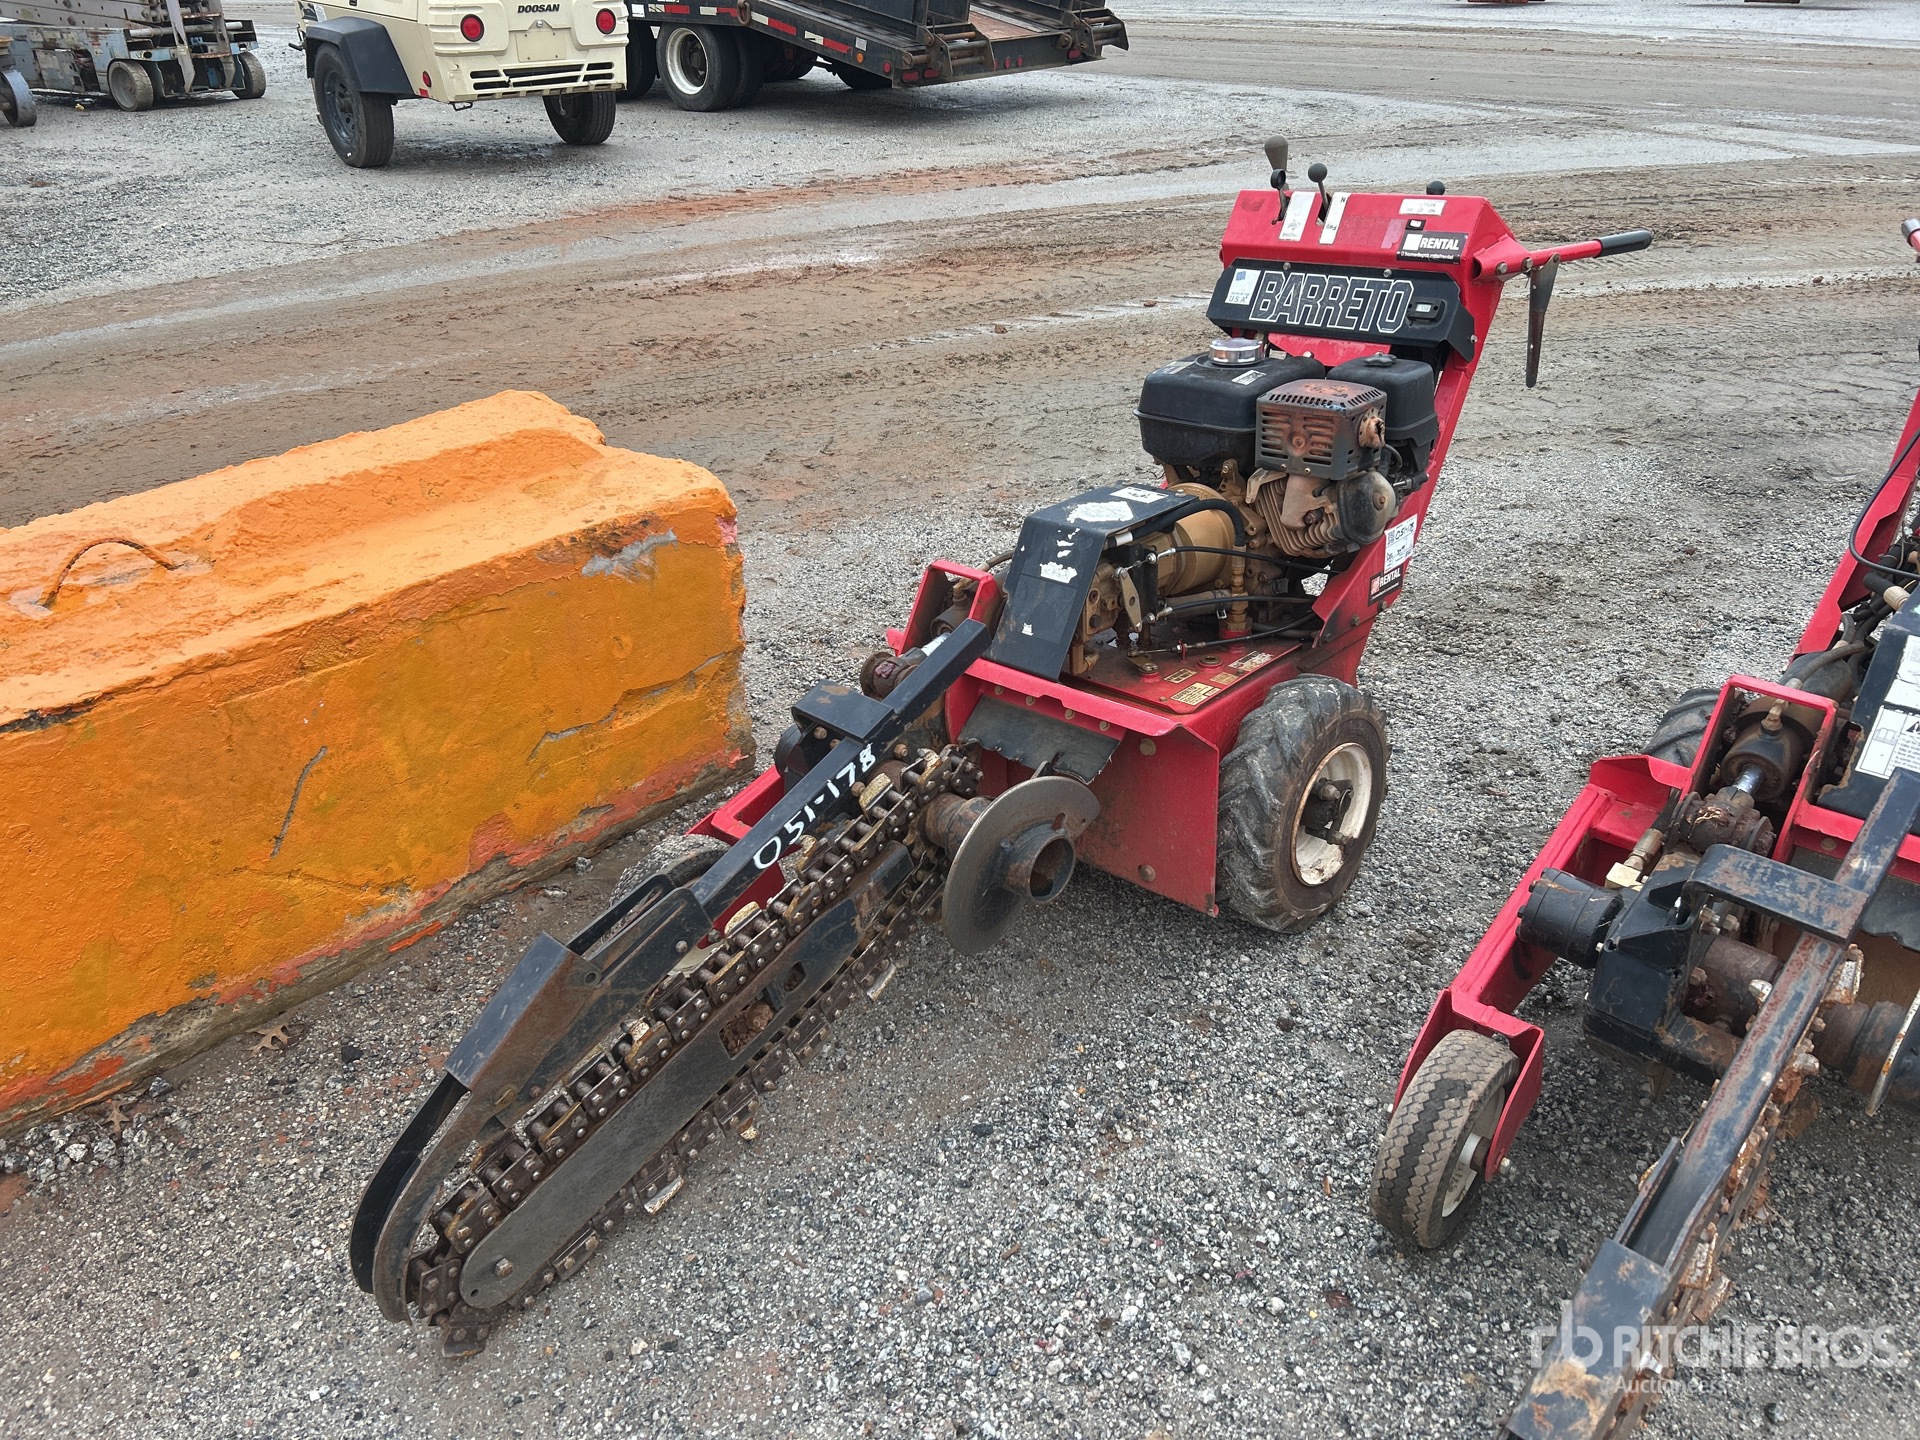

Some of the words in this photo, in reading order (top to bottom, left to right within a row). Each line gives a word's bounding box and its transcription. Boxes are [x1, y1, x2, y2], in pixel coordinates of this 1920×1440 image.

[517, 4, 560, 13] DOOSAN
[1419, 237, 1460, 251] RENTAL
[1248, 270, 1415, 334] BARRETO
[1379, 568, 1401, 588] RENTAL
[752, 742, 877, 870] 051-178
